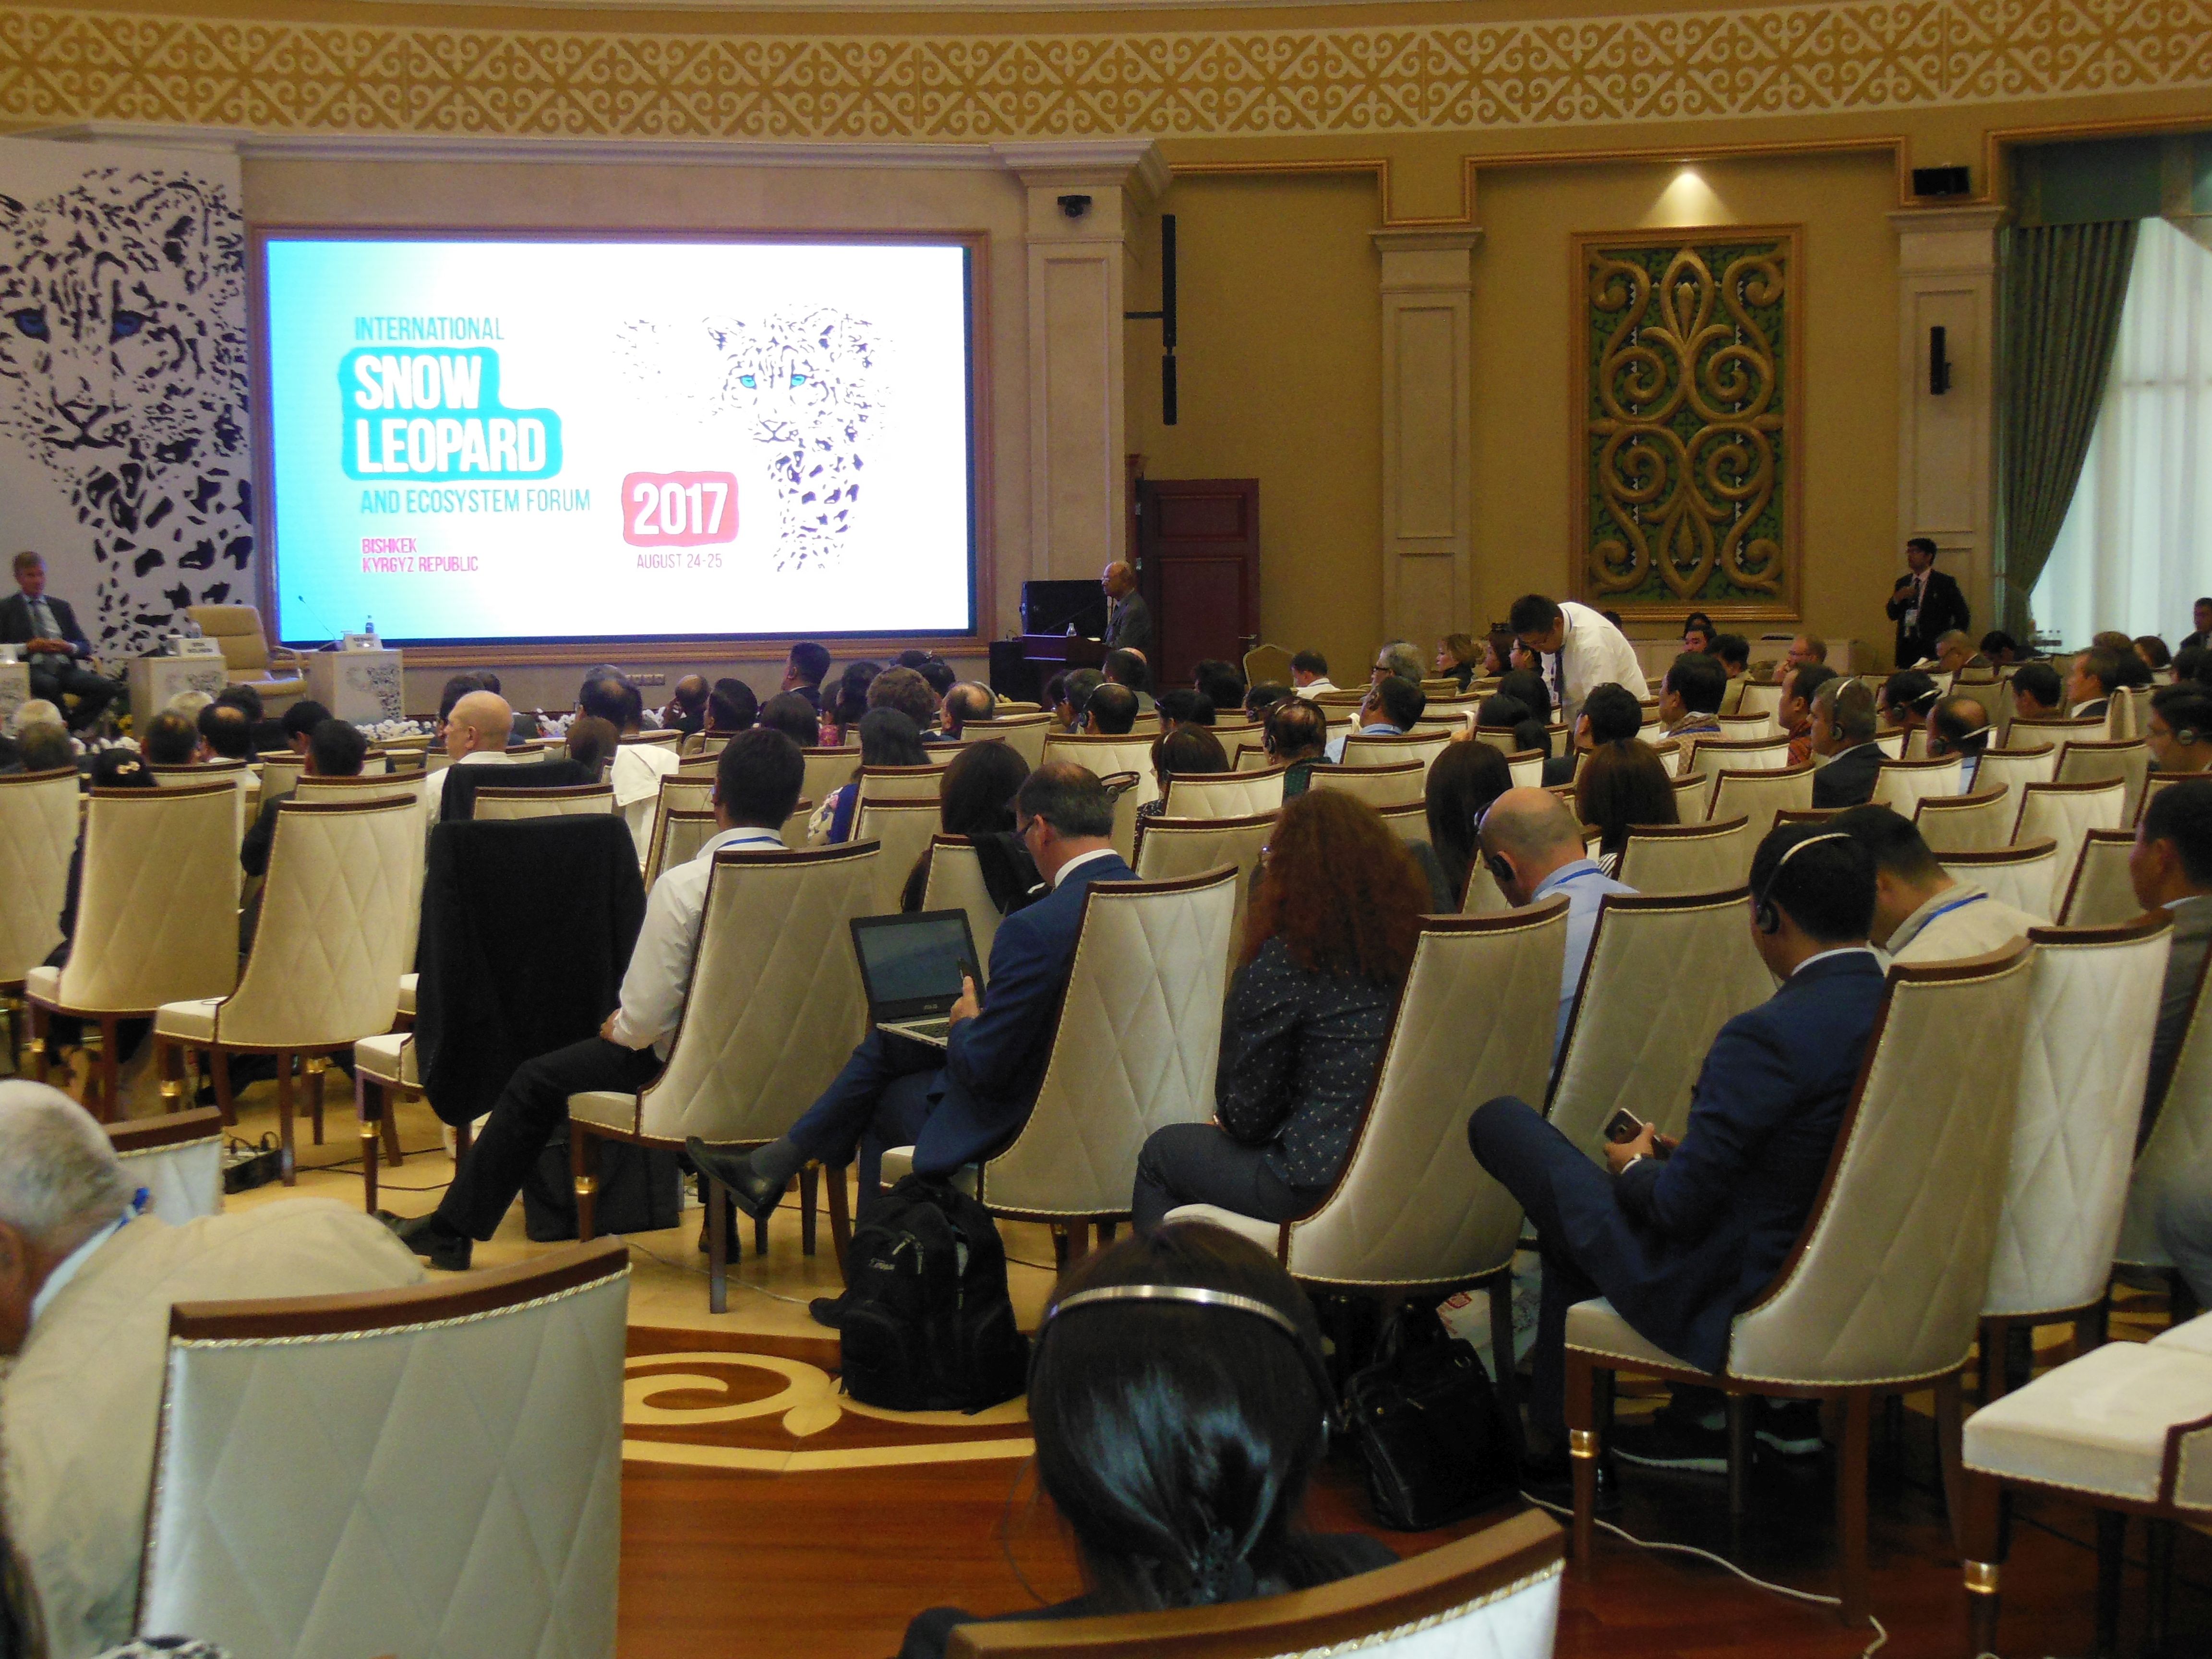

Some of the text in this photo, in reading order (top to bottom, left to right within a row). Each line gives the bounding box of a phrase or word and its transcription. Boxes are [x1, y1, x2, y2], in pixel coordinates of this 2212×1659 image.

[354, 317, 505, 340] INTERNATIONAL
[355, 354, 481, 410] SNOW
[356, 418, 547, 473] LEOPARD
[361, 489, 590, 514] AND ECOSYSTEM FORUM
[633, 482, 729, 535] 2017
[362, 538, 417, 553] BISHKEK
[362, 556, 478, 573] KYRGYZ REPUBLIC
[637, 553, 722, 569] AUGUST 24-25
